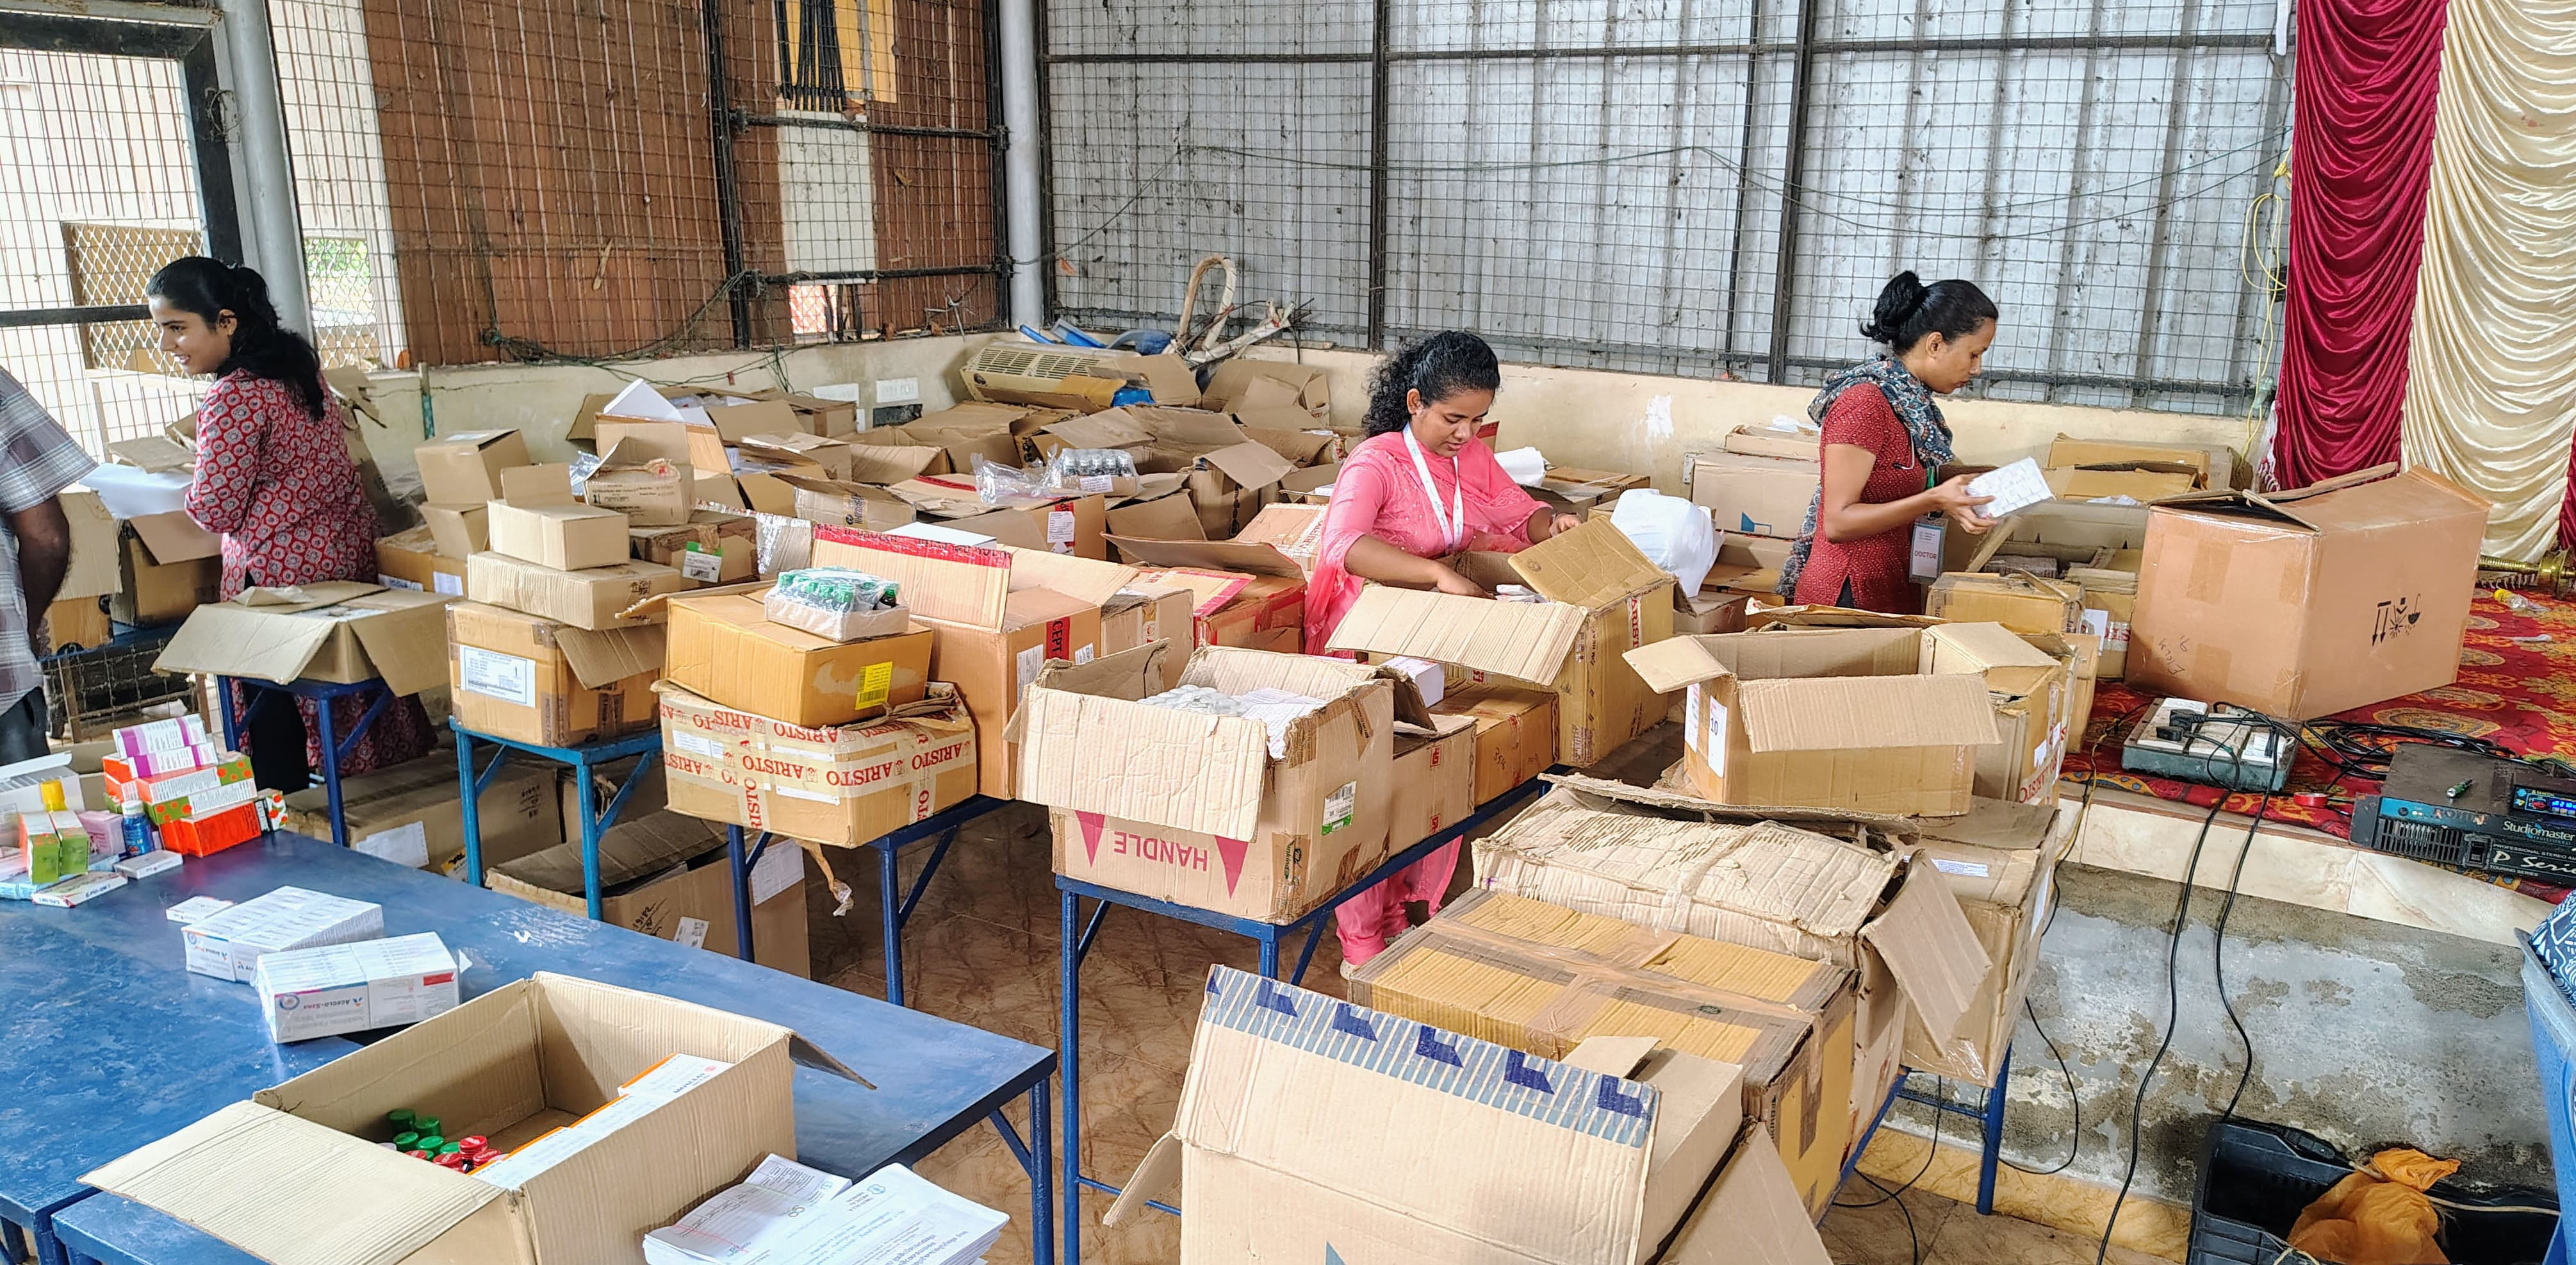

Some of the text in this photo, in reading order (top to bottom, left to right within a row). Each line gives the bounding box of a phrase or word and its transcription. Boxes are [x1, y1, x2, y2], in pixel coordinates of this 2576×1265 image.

[1914, 550, 1937, 559] DOCTOR
[1710, 717, 1718, 736] 10
[912, 742, 963, 770] ARISTO
[742, 754, 804, 780] ARISTO
[826, 761, 893, 786] ARISTO
[2503, 820, 2575, 841] Studiomaster
[1114, 831, 1208, 872] HANDLE
[2493, 844, 2540, 855] PROFESSIONAL
[2541, 851, 2566, 859] STEREO
[2493, 850, 2511, 863] P
[2491, 865, 2515, 873] TOURING
